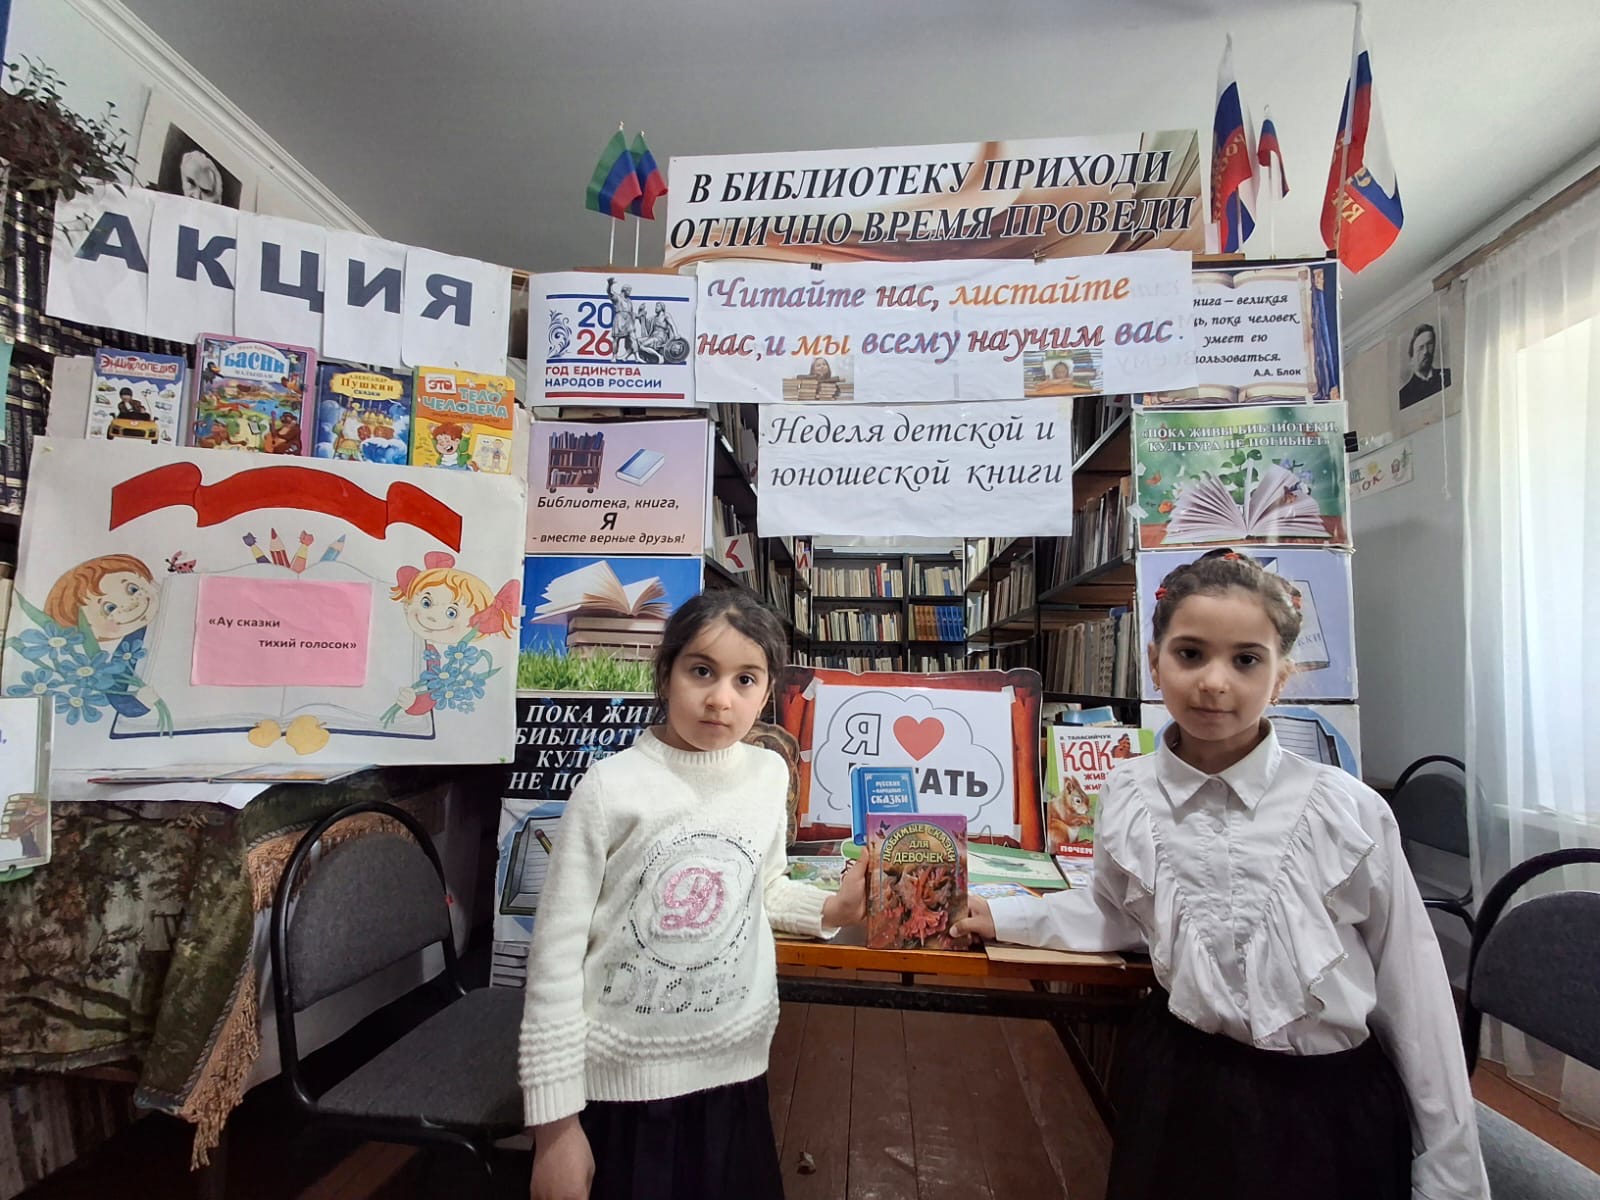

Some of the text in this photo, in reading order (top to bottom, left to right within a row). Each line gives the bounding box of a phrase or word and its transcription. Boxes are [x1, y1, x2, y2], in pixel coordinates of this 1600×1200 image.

[687, 173, 713, 204] В
[720, 161, 973, 203] БИБЛИОТЕКУ
[981, 150, 1173, 193] ПРИХОДИ
[670, 197, 1196, 249] ОТЛИЧНО ВРЕМЯ ПРОВЕДИ
[74, 211, 473, 327] АКЦИЯ
[708, 274, 1130, 311] Читайте нас, листайте
[1236, 294, 1288, 306] великая
[1212, 316, 1241, 327] пока
[1248, 312, 1301, 325] человек
[791, 335, 850, 356] мы
[862, 330, 960, 364] всему
[968, 324, 1105, 362] научим
[1202, 334, 1268, 347] умеет ею
[545, 366, 641, 377] ГОД ЕДИНСТВА
[1253, 367, 1301, 377] А.А. Блок
[545, 377, 662, 388] НАРОДОВ РОССИИ
[460, 388, 502, 404] ТЕЛО
[424, 397, 509, 418] ЧЕЛОВЕКА
[768, 412, 1056, 449] Неделя детской и
[1190, 426, 1232, 438] ЖИВЫ
[1148, 440, 1220, 452] КУЛЬТУРА
[1225, 439, 1243, 449] НЕ
[771, 458, 1063, 492] юношеской книги
[537, 496, 680, 511] Библиотека, книга,
[600, 512, 618, 531] Я
[540, 533, 586, 543] вместе
[590, 534, 636, 545] верные
[639, 533, 686, 545] друзья!
[208, 617, 281, 628] «Ау сказки
[258, 637, 357, 650] тихий голосок»
[525, 705, 593, 724] ПОКА
[841, 712, 881, 756] Я
[508, 772, 544, 790] НЕ
[871, 795, 909, 806] СКАЗКИ
[882, 824, 957, 862] ЛЮБИМЫЕ СКАЗКИ
[909, 841, 930, 849] ДЛЯ
[894, 852, 944, 865] ДЕВОЧЕК
